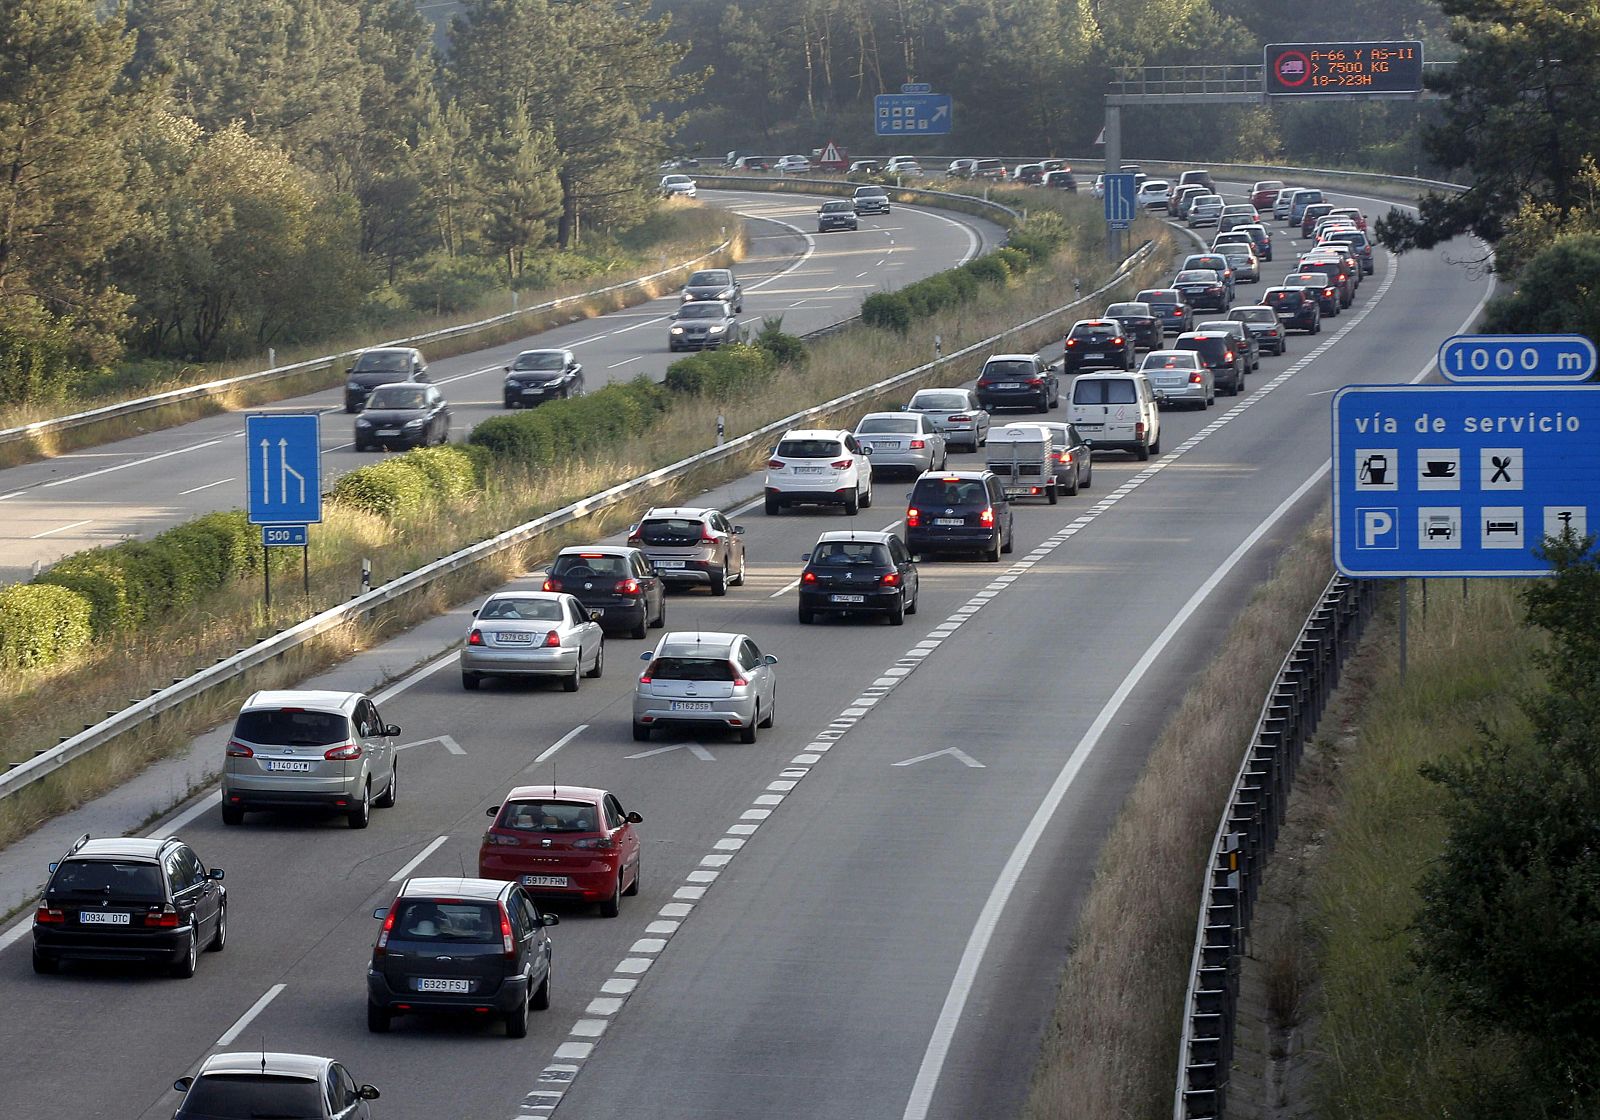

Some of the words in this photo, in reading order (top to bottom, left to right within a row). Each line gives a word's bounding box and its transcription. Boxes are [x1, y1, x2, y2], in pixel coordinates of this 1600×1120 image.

[1311, 50, 1345, 60] A-66
[1354, 50, 1363, 60] Y
[1371, 48, 1413, 60] AS-II
[1328, 62, 1363, 73] 7500
[1371, 62, 1389, 73] KG
[1454, 348, 1539, 371] 1000
[1557, 352, 1582, 370] m
[1355, 412, 1397, 433] vía
[1415, 413, 1446, 433] de
[1464, 412, 1580, 433] servicio
[1364, 512, 1392, 546] P
[268, 531, 290, 541] 500
[500, 633, 516, 641] 7579
[676, 702, 694, 710] 5162
[272, 761, 291, 769] 1140
[527, 877, 547, 885] 5917
[549, 877, 565, 886] FHN
[85, 913, 105, 922] 0934
[112, 914, 128, 923] DTC
[423, 979, 447, 989] 6329
[449, 981, 467, 990] FSJ
